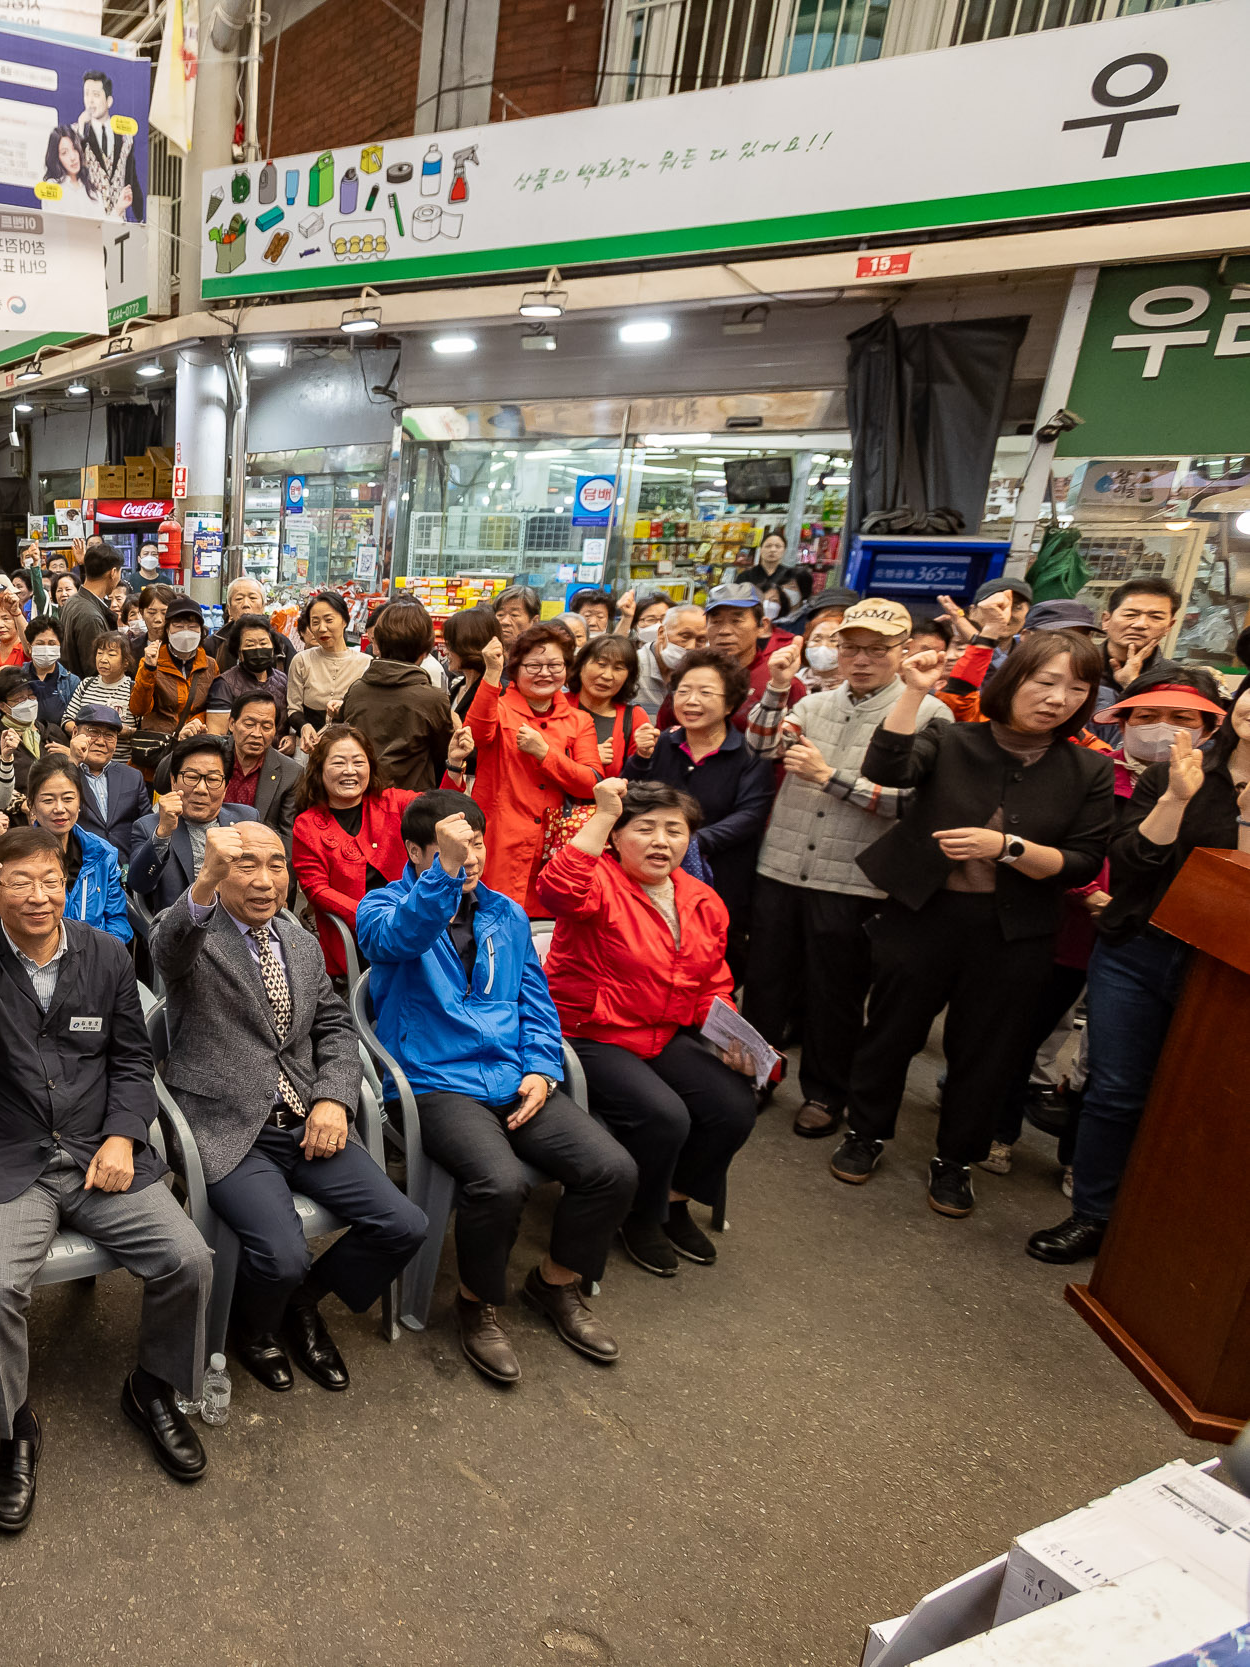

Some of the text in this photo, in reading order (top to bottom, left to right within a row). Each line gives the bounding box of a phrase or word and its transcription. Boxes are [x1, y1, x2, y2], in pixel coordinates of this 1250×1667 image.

[1061, 52, 1180, 159] 우
[514, 164, 569, 193] 상품의
[659, 148, 698, 175] 뭐든
[709, 149, 729, 161] 다
[870, 256, 892, 272] 15
[584, 488, 612, 501] 담배
[915, 566, 948, 582] 365
